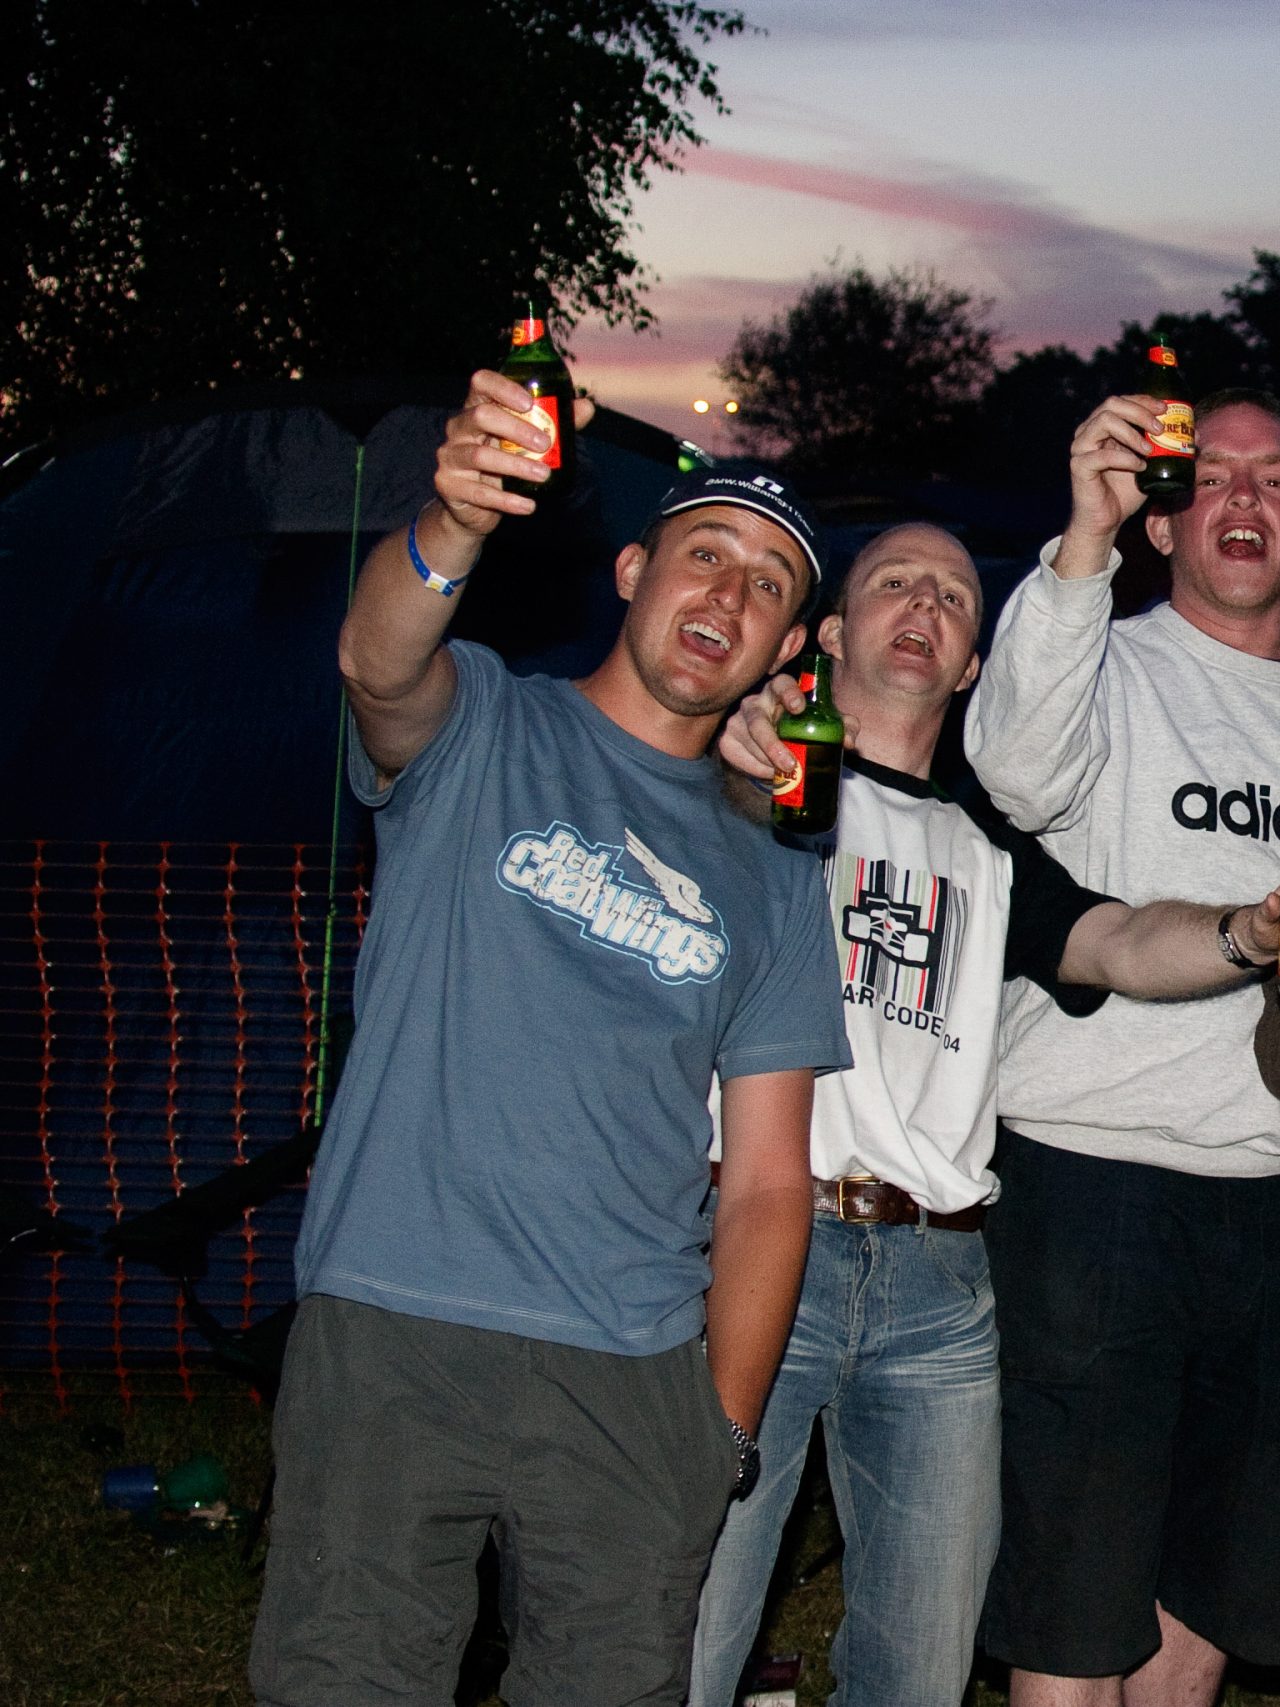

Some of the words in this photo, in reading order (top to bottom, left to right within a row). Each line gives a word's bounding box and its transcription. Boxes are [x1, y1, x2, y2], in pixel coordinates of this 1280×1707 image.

[549, 829, 610, 881] Red
[884, 1001, 944, 1037] CODE
[944, 1034, 960, 1053] 04
